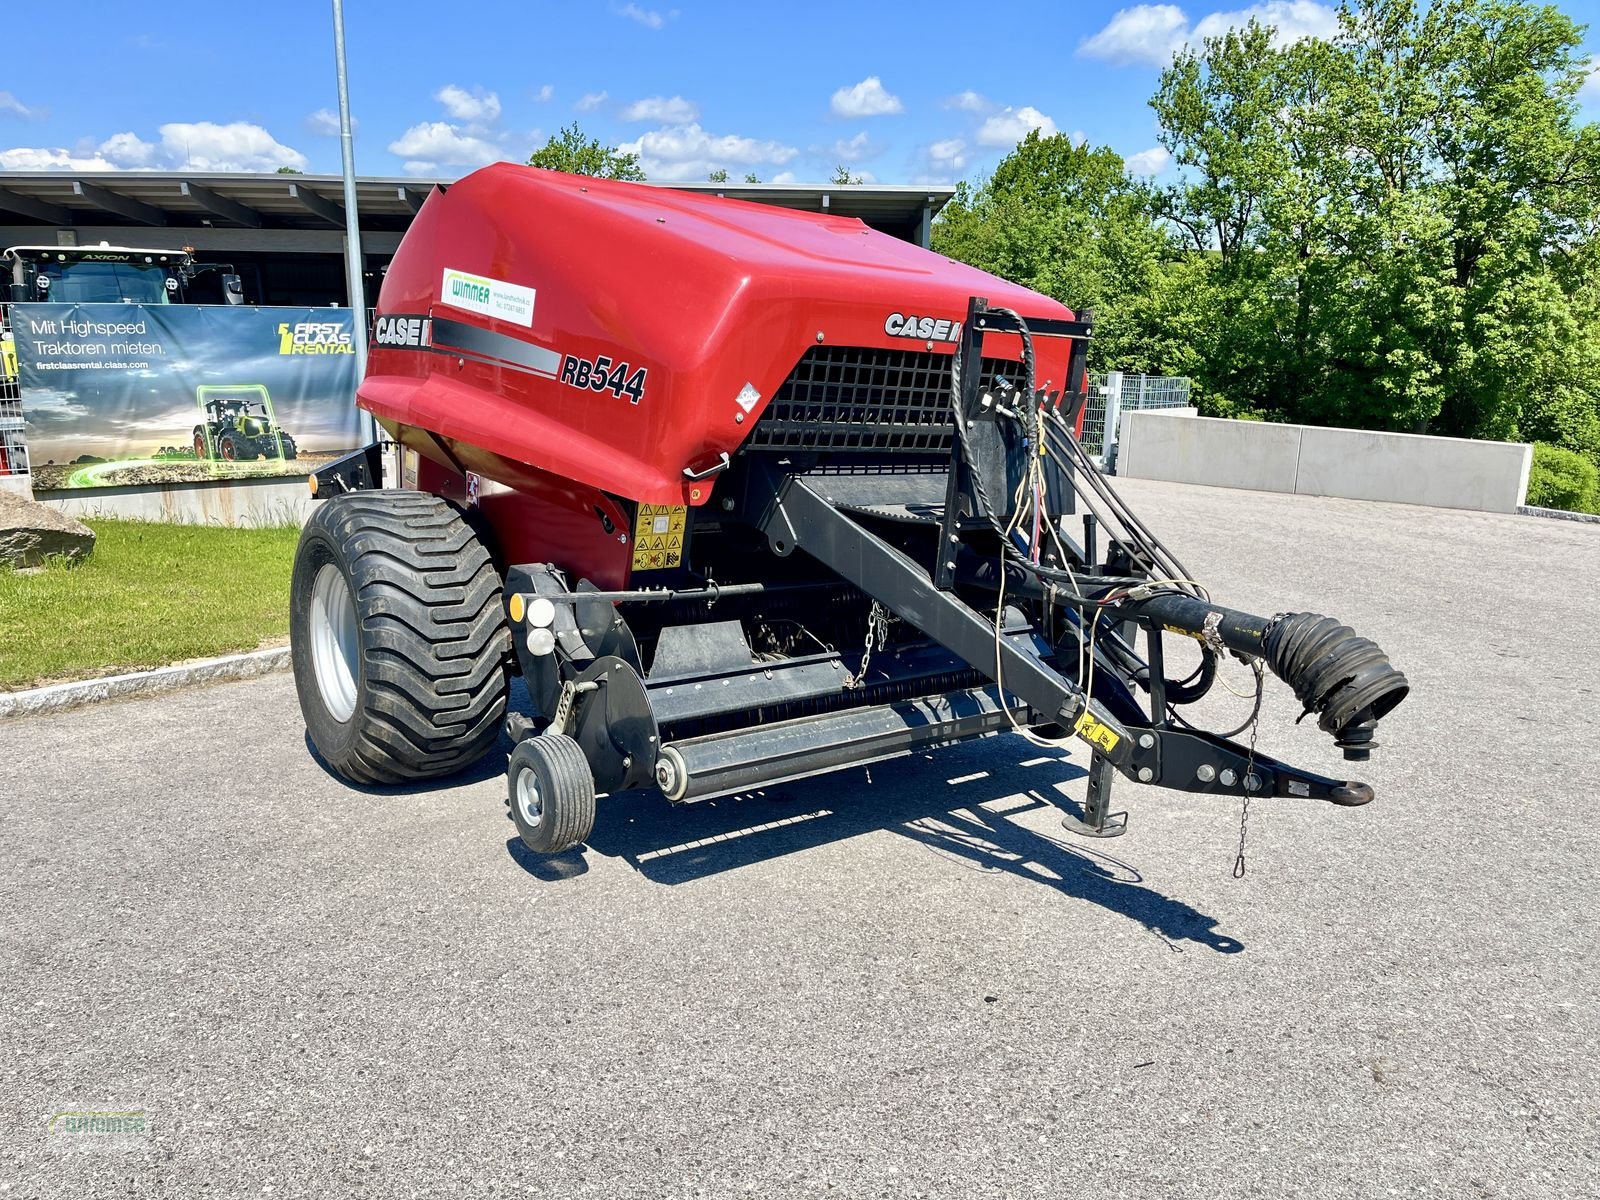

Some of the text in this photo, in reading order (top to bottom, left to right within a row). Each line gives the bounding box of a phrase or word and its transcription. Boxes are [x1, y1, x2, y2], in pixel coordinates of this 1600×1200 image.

[452, 279, 491, 304] WIMMER
[31, 320, 146, 338] Mit Highspeed
[294, 322, 344, 335] FIRST
[293, 333, 351, 345] CLAAS
[32, 340, 166, 355] Traktoren mieten.
[291, 343, 356, 355] RENTAL
[36, 361, 149, 370] firstclaasrental.claas.com
[560, 354, 648, 405] RB544
